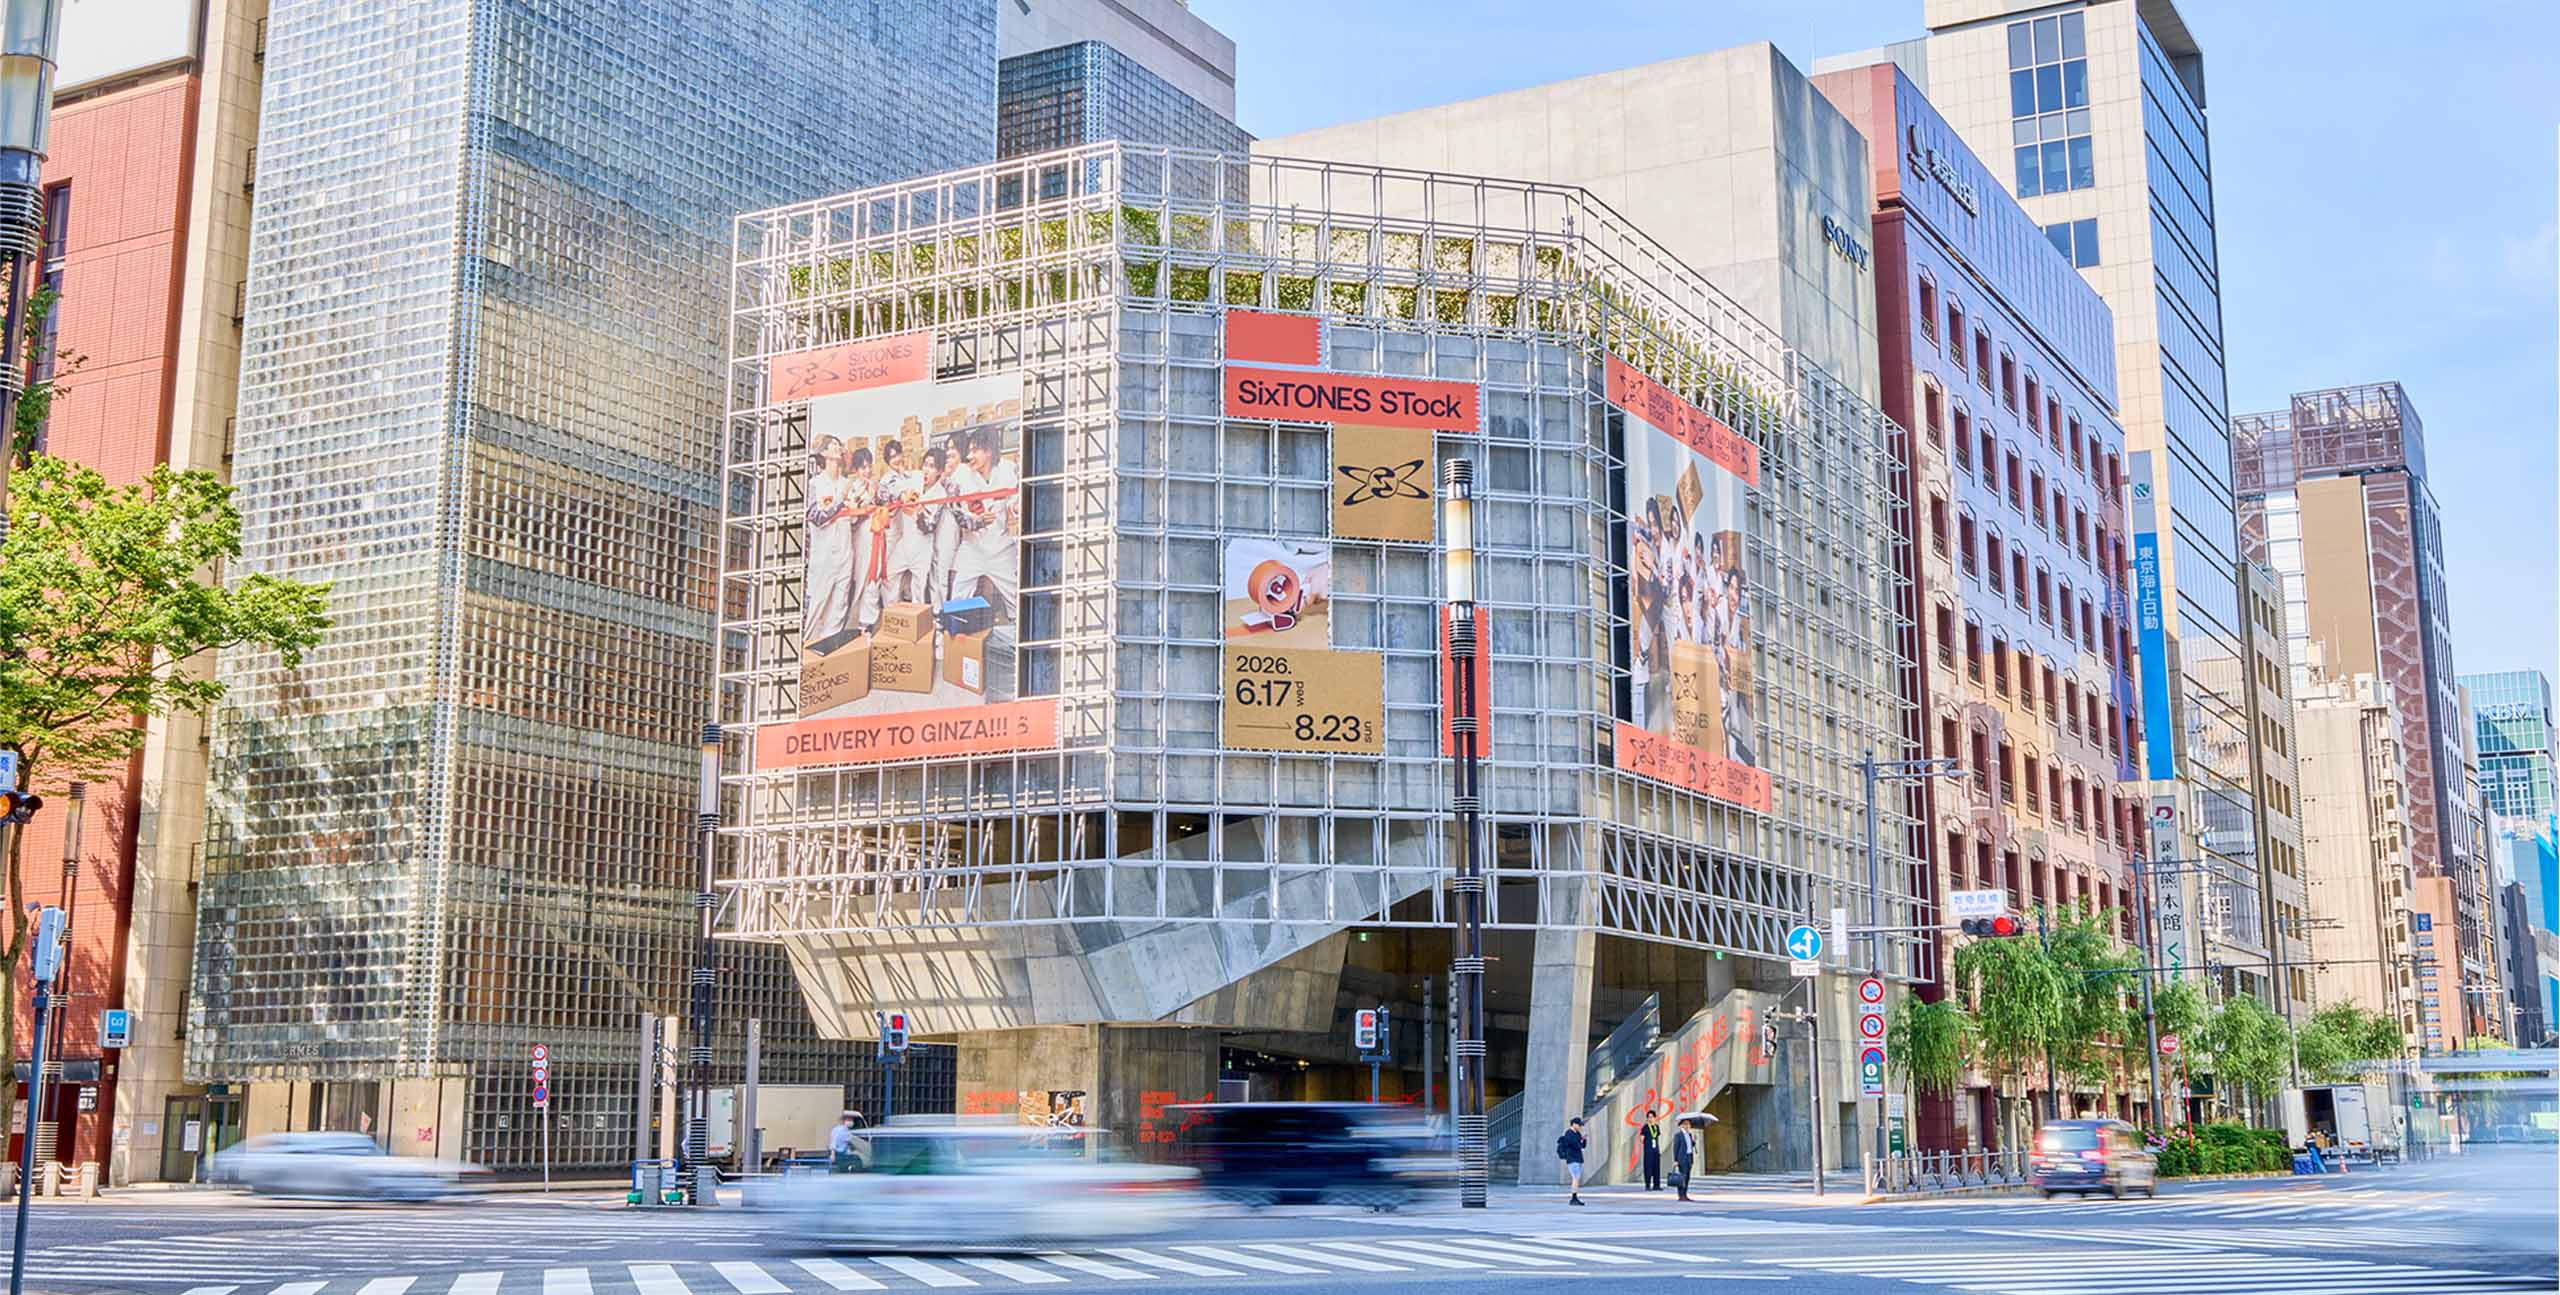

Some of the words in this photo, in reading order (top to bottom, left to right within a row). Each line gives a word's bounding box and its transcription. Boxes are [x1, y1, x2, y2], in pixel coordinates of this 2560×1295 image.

[1824, 215, 1870, 271] SONY
[848, 365, 889, 382] STock
[1238, 379, 1372, 413] SixTONES
[1380, 389, 1462, 418] STock
[2138, 546, 2159, 631] 東京海上日動
[1236, 655, 1292, 675] 2026.
[1236, 678, 1292, 707] 6.17
[1294, 680, 1305, 707] wed
[786, 728, 881, 755] DELIVERY
[887, 725, 915, 746] TO
[921, 716, 1009, 743] GINZA!!!
[1295, 714, 1361, 743] 8.23
[1364, 721, 1372, 744] sun
